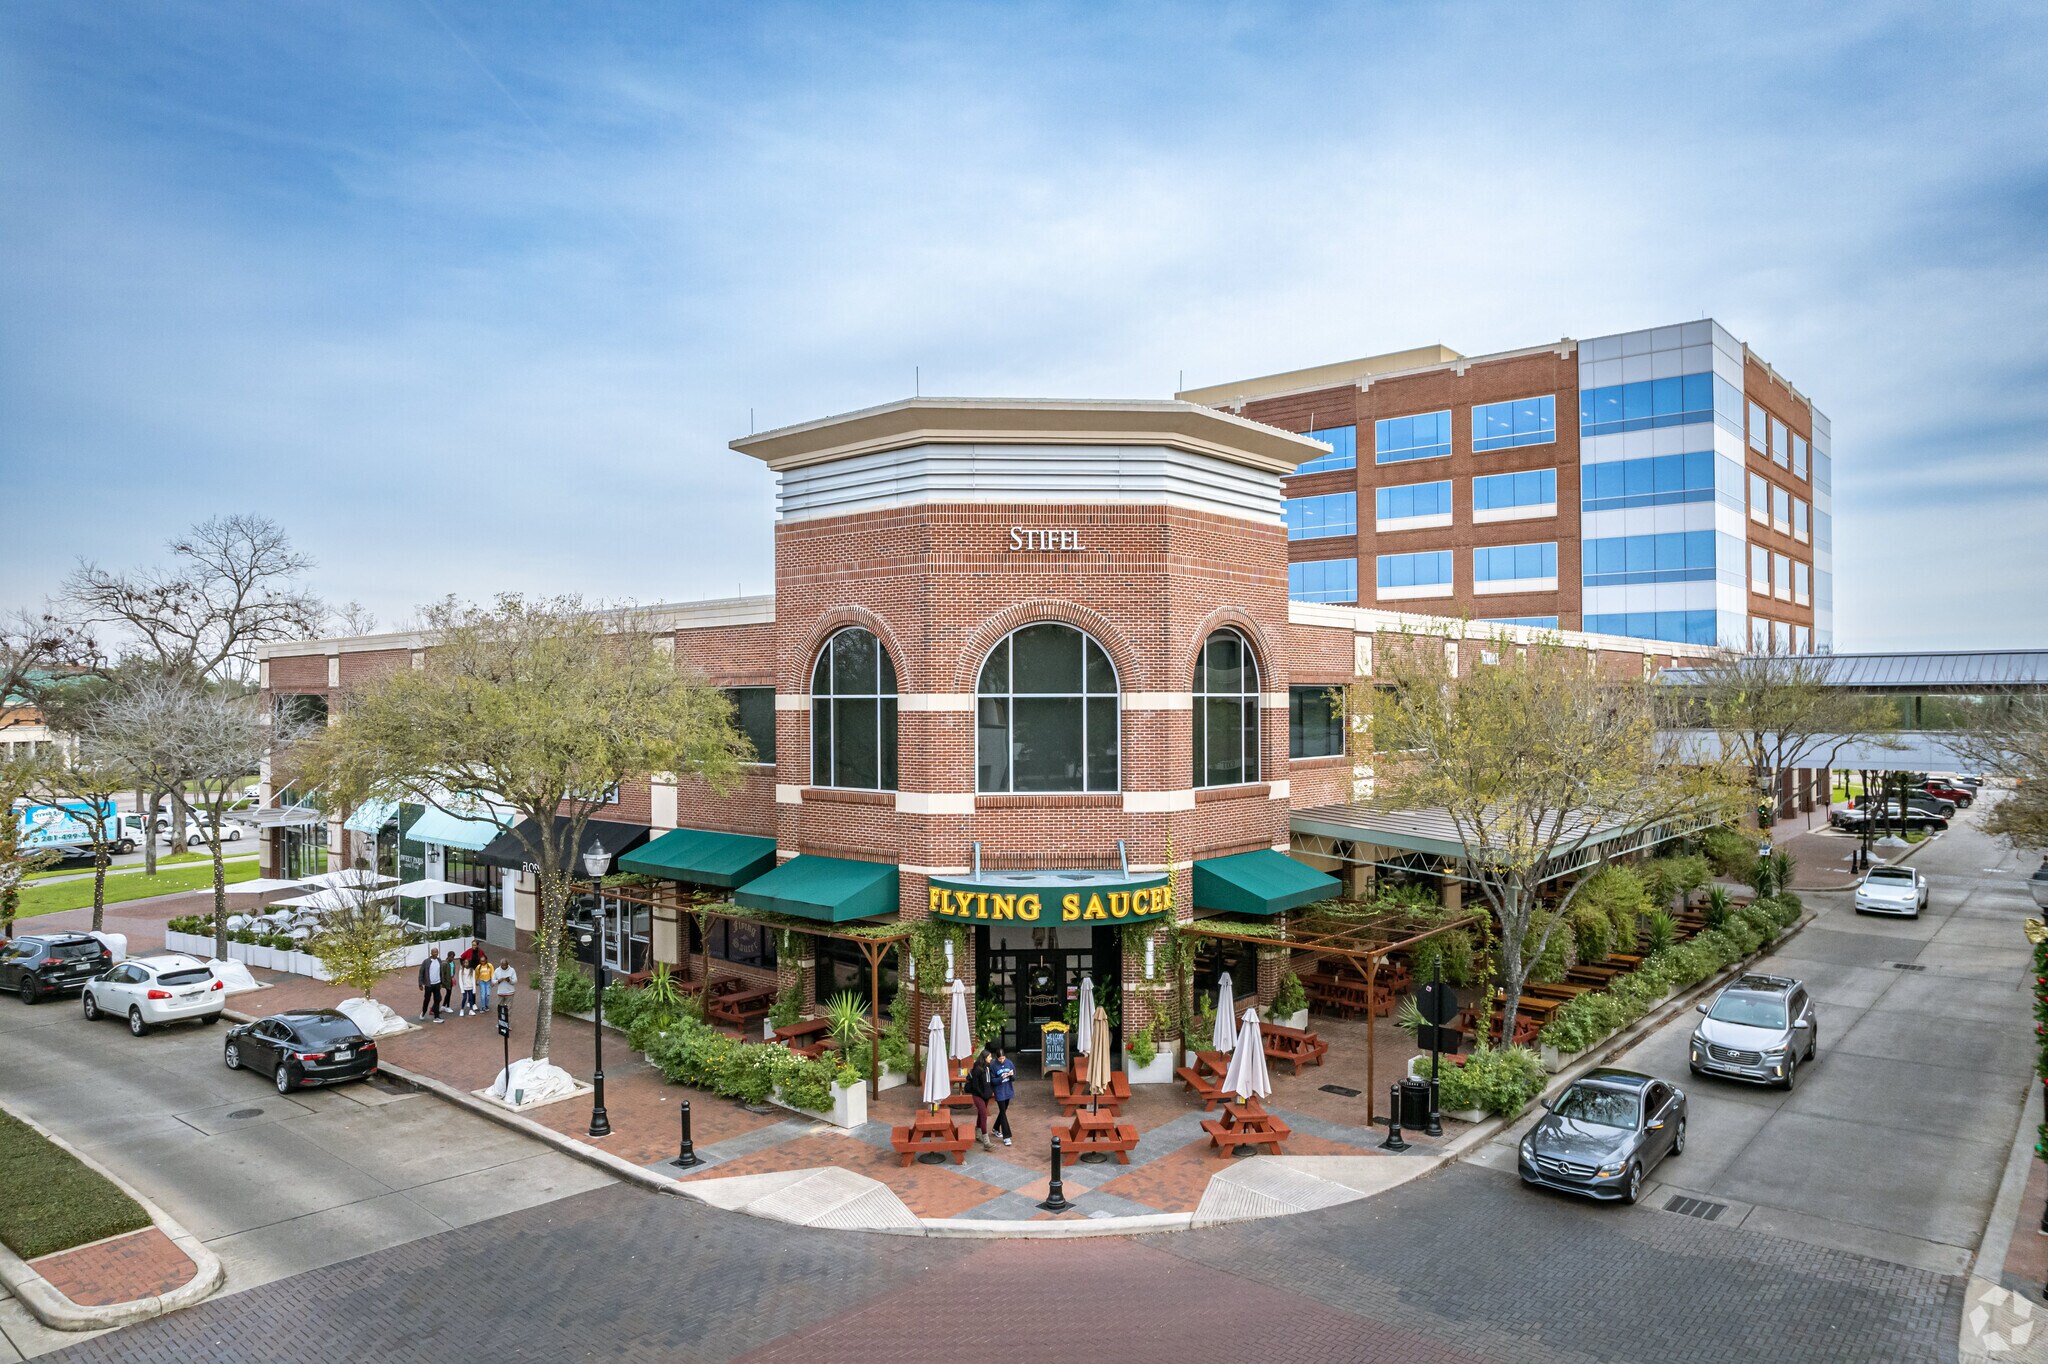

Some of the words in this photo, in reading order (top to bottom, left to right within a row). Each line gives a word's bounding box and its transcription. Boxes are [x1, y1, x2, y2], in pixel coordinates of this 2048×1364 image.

[1010, 526, 1085, 551] STIFEL
[41, 832, 90, 842] 281-499-3
[928, 886, 1041, 921] FLYING
[1062, 885, 1172, 921] SAUCER
